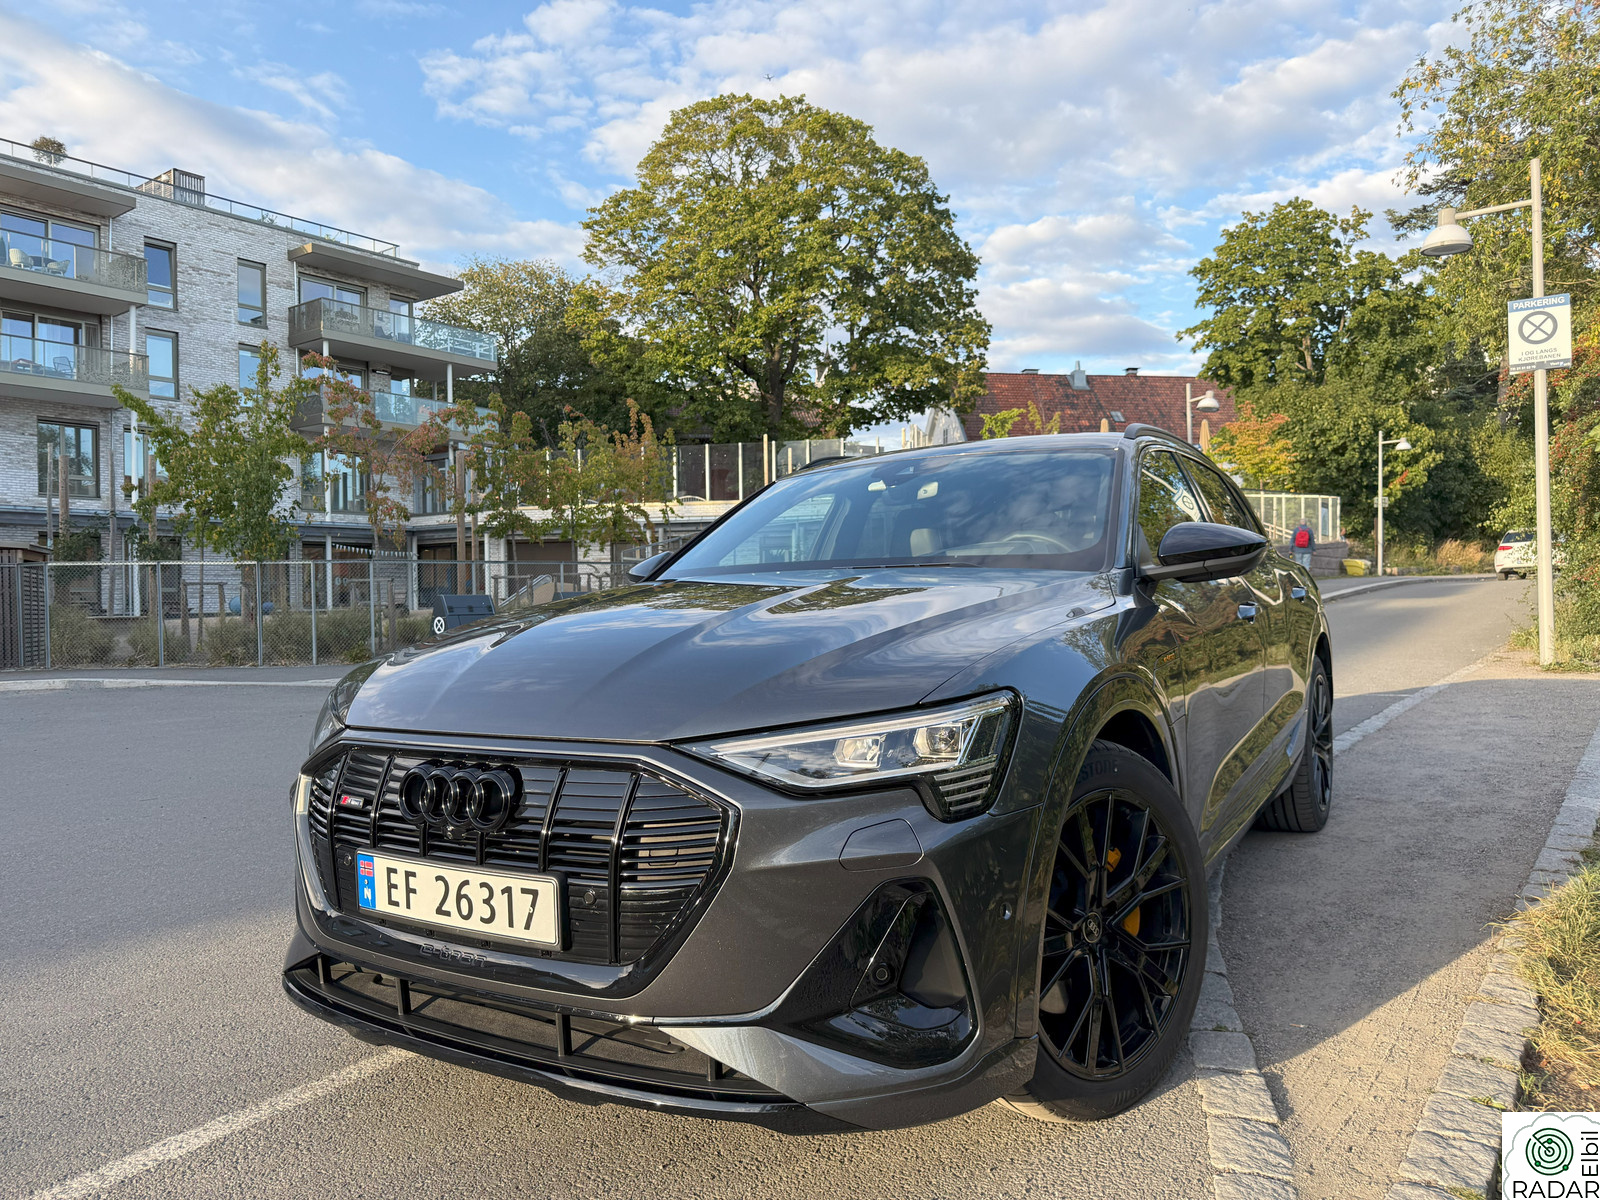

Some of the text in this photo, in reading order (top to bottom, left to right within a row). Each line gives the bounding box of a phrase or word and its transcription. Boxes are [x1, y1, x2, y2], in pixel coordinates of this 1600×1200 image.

[1513, 296, 1565, 310] PARKERING
[1518, 353, 1561, 362] KJØREBANEN
[364, 887, 372, 900] N
[386, 866, 539, 931] EF 26317
[420, 943, 488, 968] e-tron
